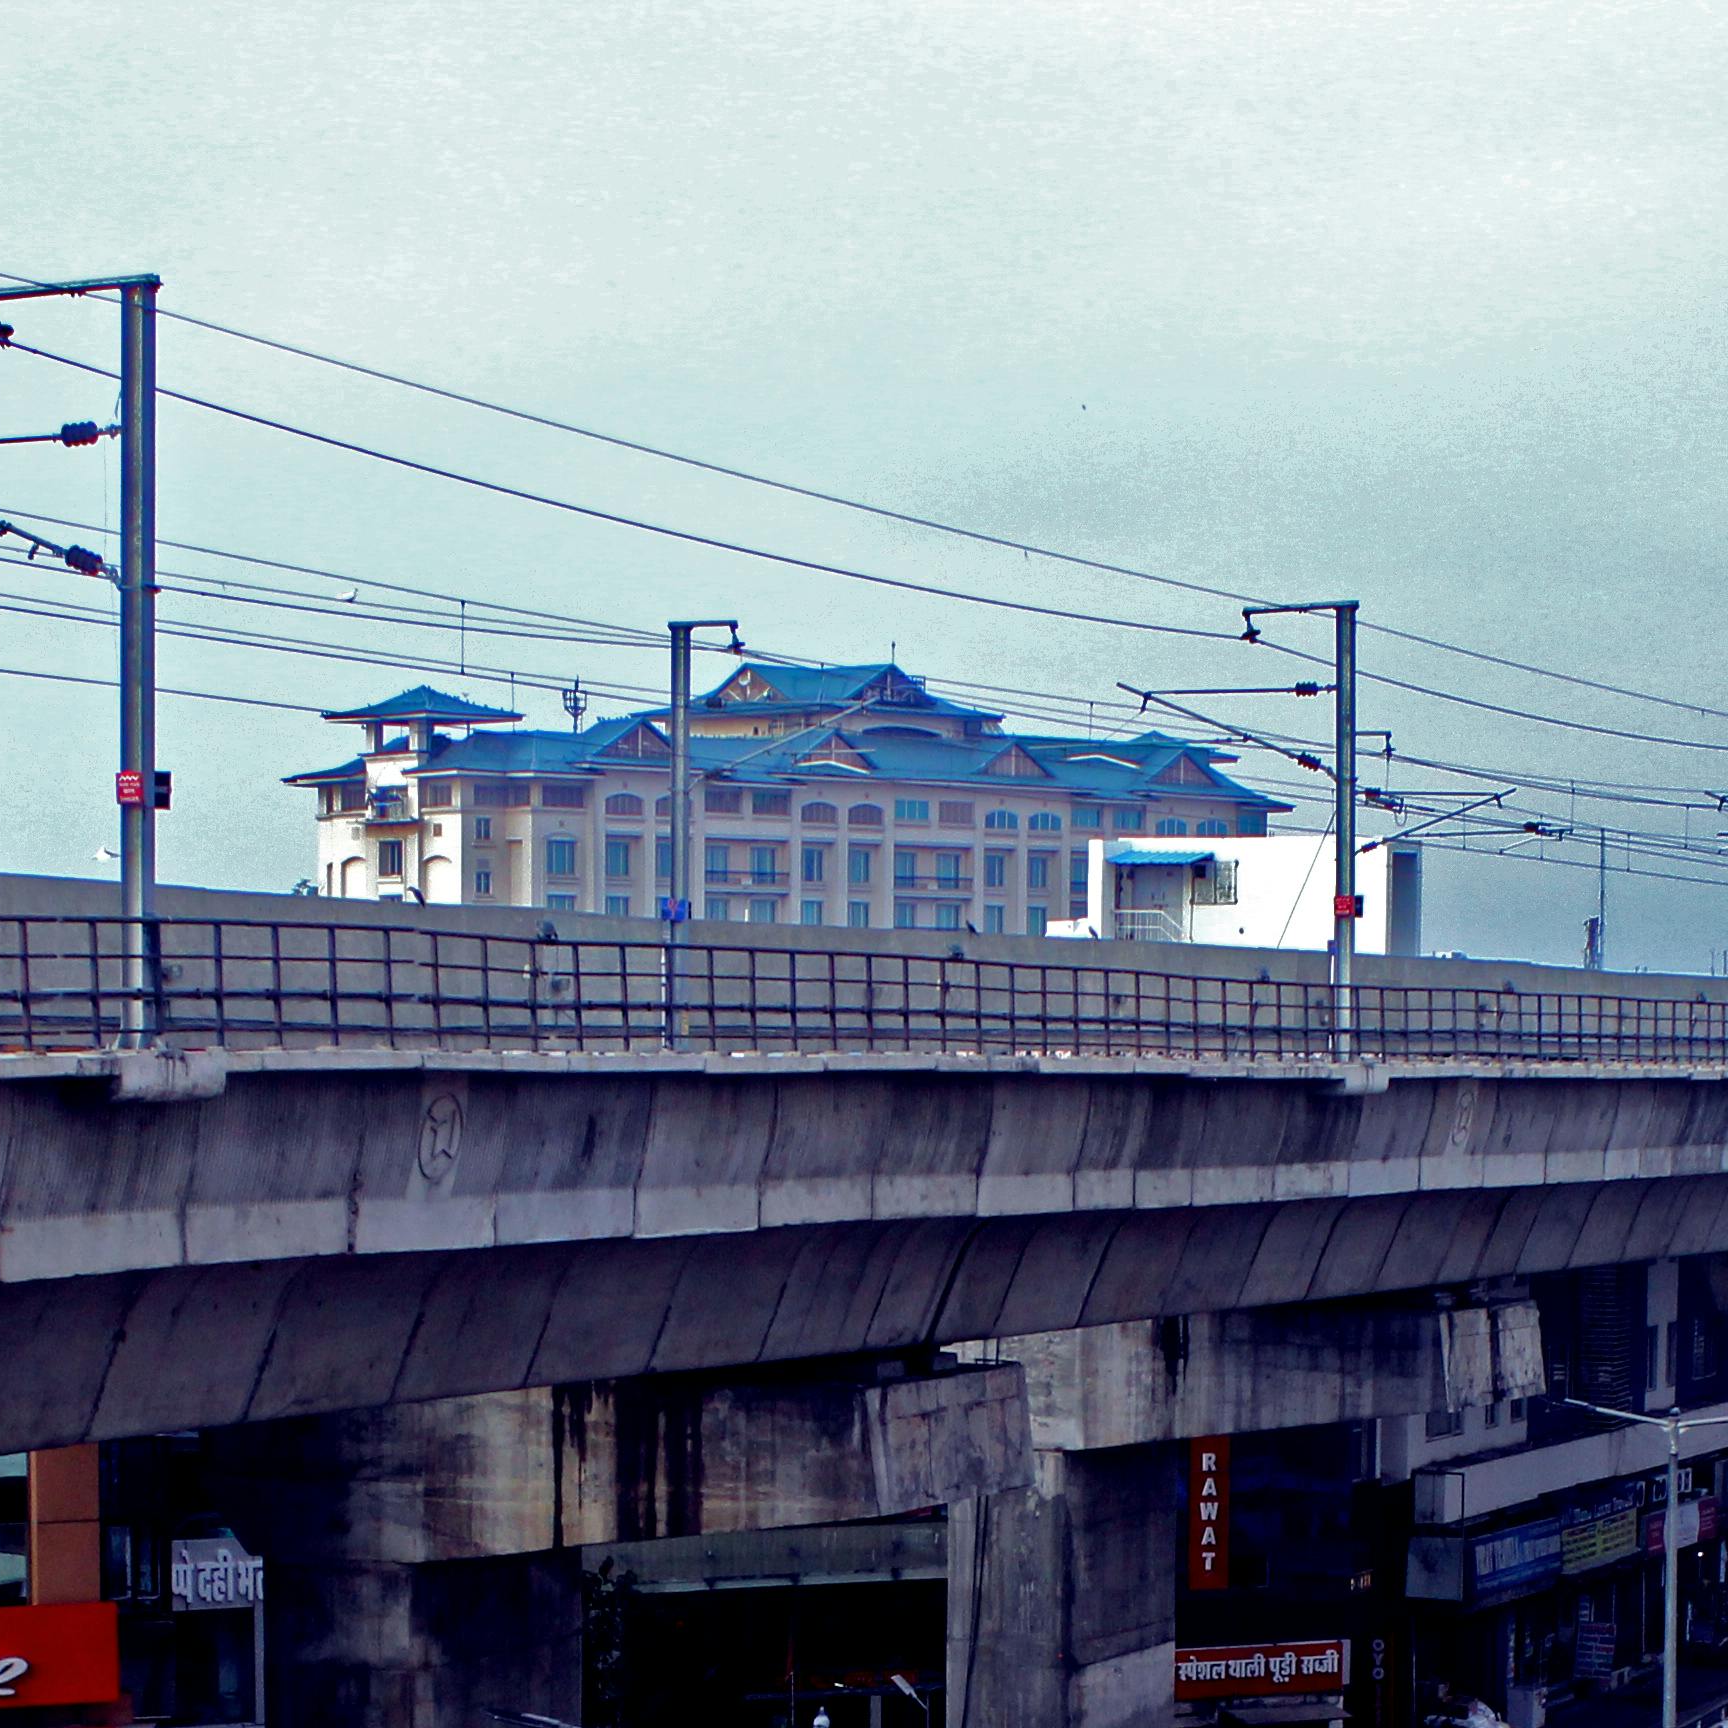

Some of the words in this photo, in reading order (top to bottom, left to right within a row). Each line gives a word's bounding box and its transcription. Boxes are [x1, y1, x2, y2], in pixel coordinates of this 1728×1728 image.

[1200, 1453, 1219, 1571] RAWAT
[196, 1548, 233, 1602] दही
[1177, 1655, 1227, 1681] स्पेशल
[1269, 1651, 1297, 1683] पूड़ी
[1300, 1649, 1339, 1675] सब्जी
[1373, 1639, 1385, 1679] OYO
